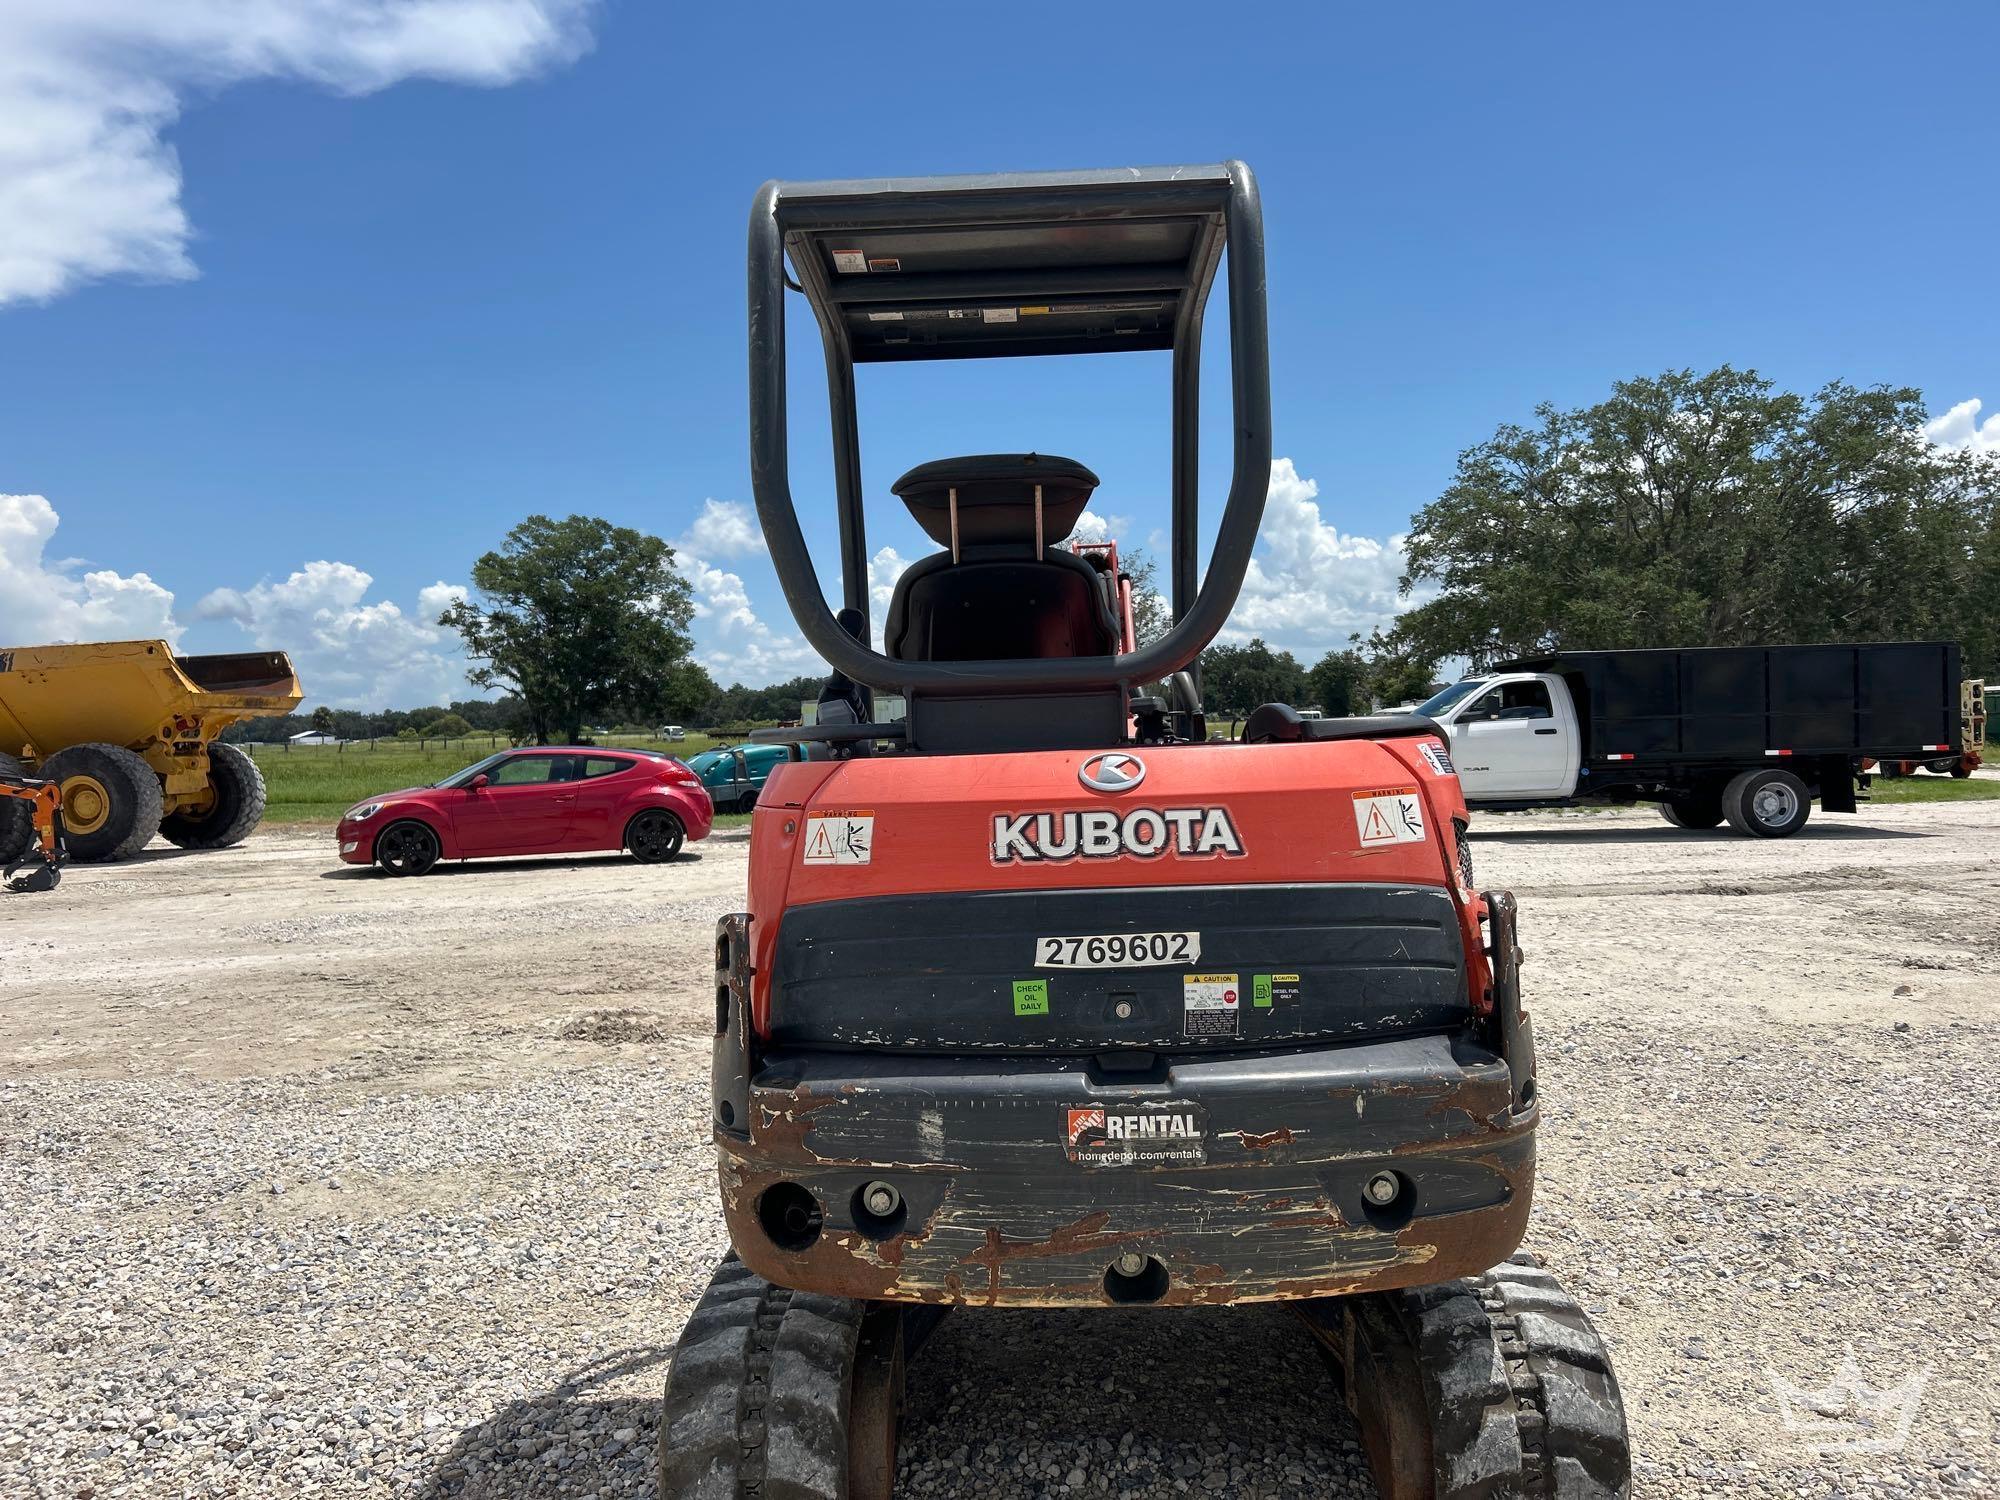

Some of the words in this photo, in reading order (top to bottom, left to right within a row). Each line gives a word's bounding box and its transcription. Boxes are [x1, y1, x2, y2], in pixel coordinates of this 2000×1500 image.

[1372, 789, 1405, 797] WARNING
[992, 808, 1244, 860] KUBOTA
[1044, 934, 1190, 964] 2769602
[1016, 985, 1043, 993] CHECK
[1020, 1002, 1042, 1011] DAILY
[1107, 1115, 1201, 1139] RENTAL
[1078, 1149, 1202, 1161] homedepot.com/rentals
